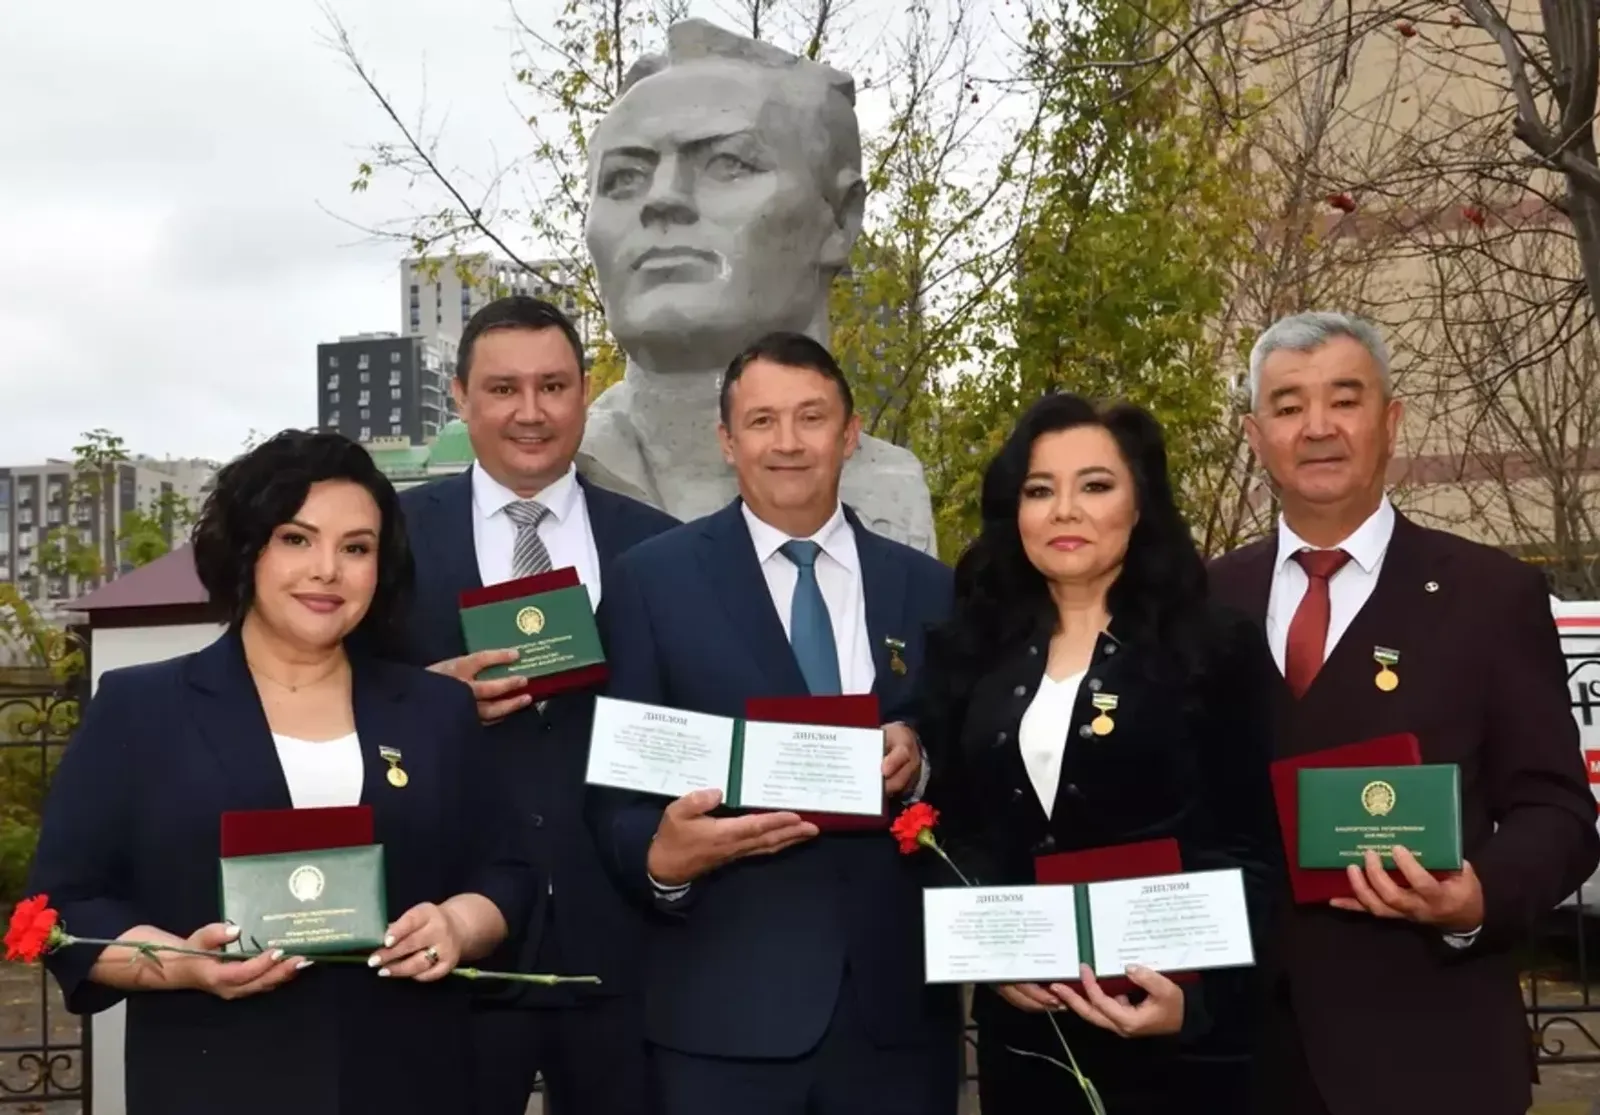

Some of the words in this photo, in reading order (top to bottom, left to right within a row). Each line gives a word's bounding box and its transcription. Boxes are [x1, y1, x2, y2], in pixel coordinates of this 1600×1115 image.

[642, 711, 689, 726] ДИПЛОМ
[792, 731, 837, 741] ДИПЛОМ
[1140, 881, 1191, 895] ДИПЛОМ
[976, 893, 1024, 904] ДИПЛОМ
